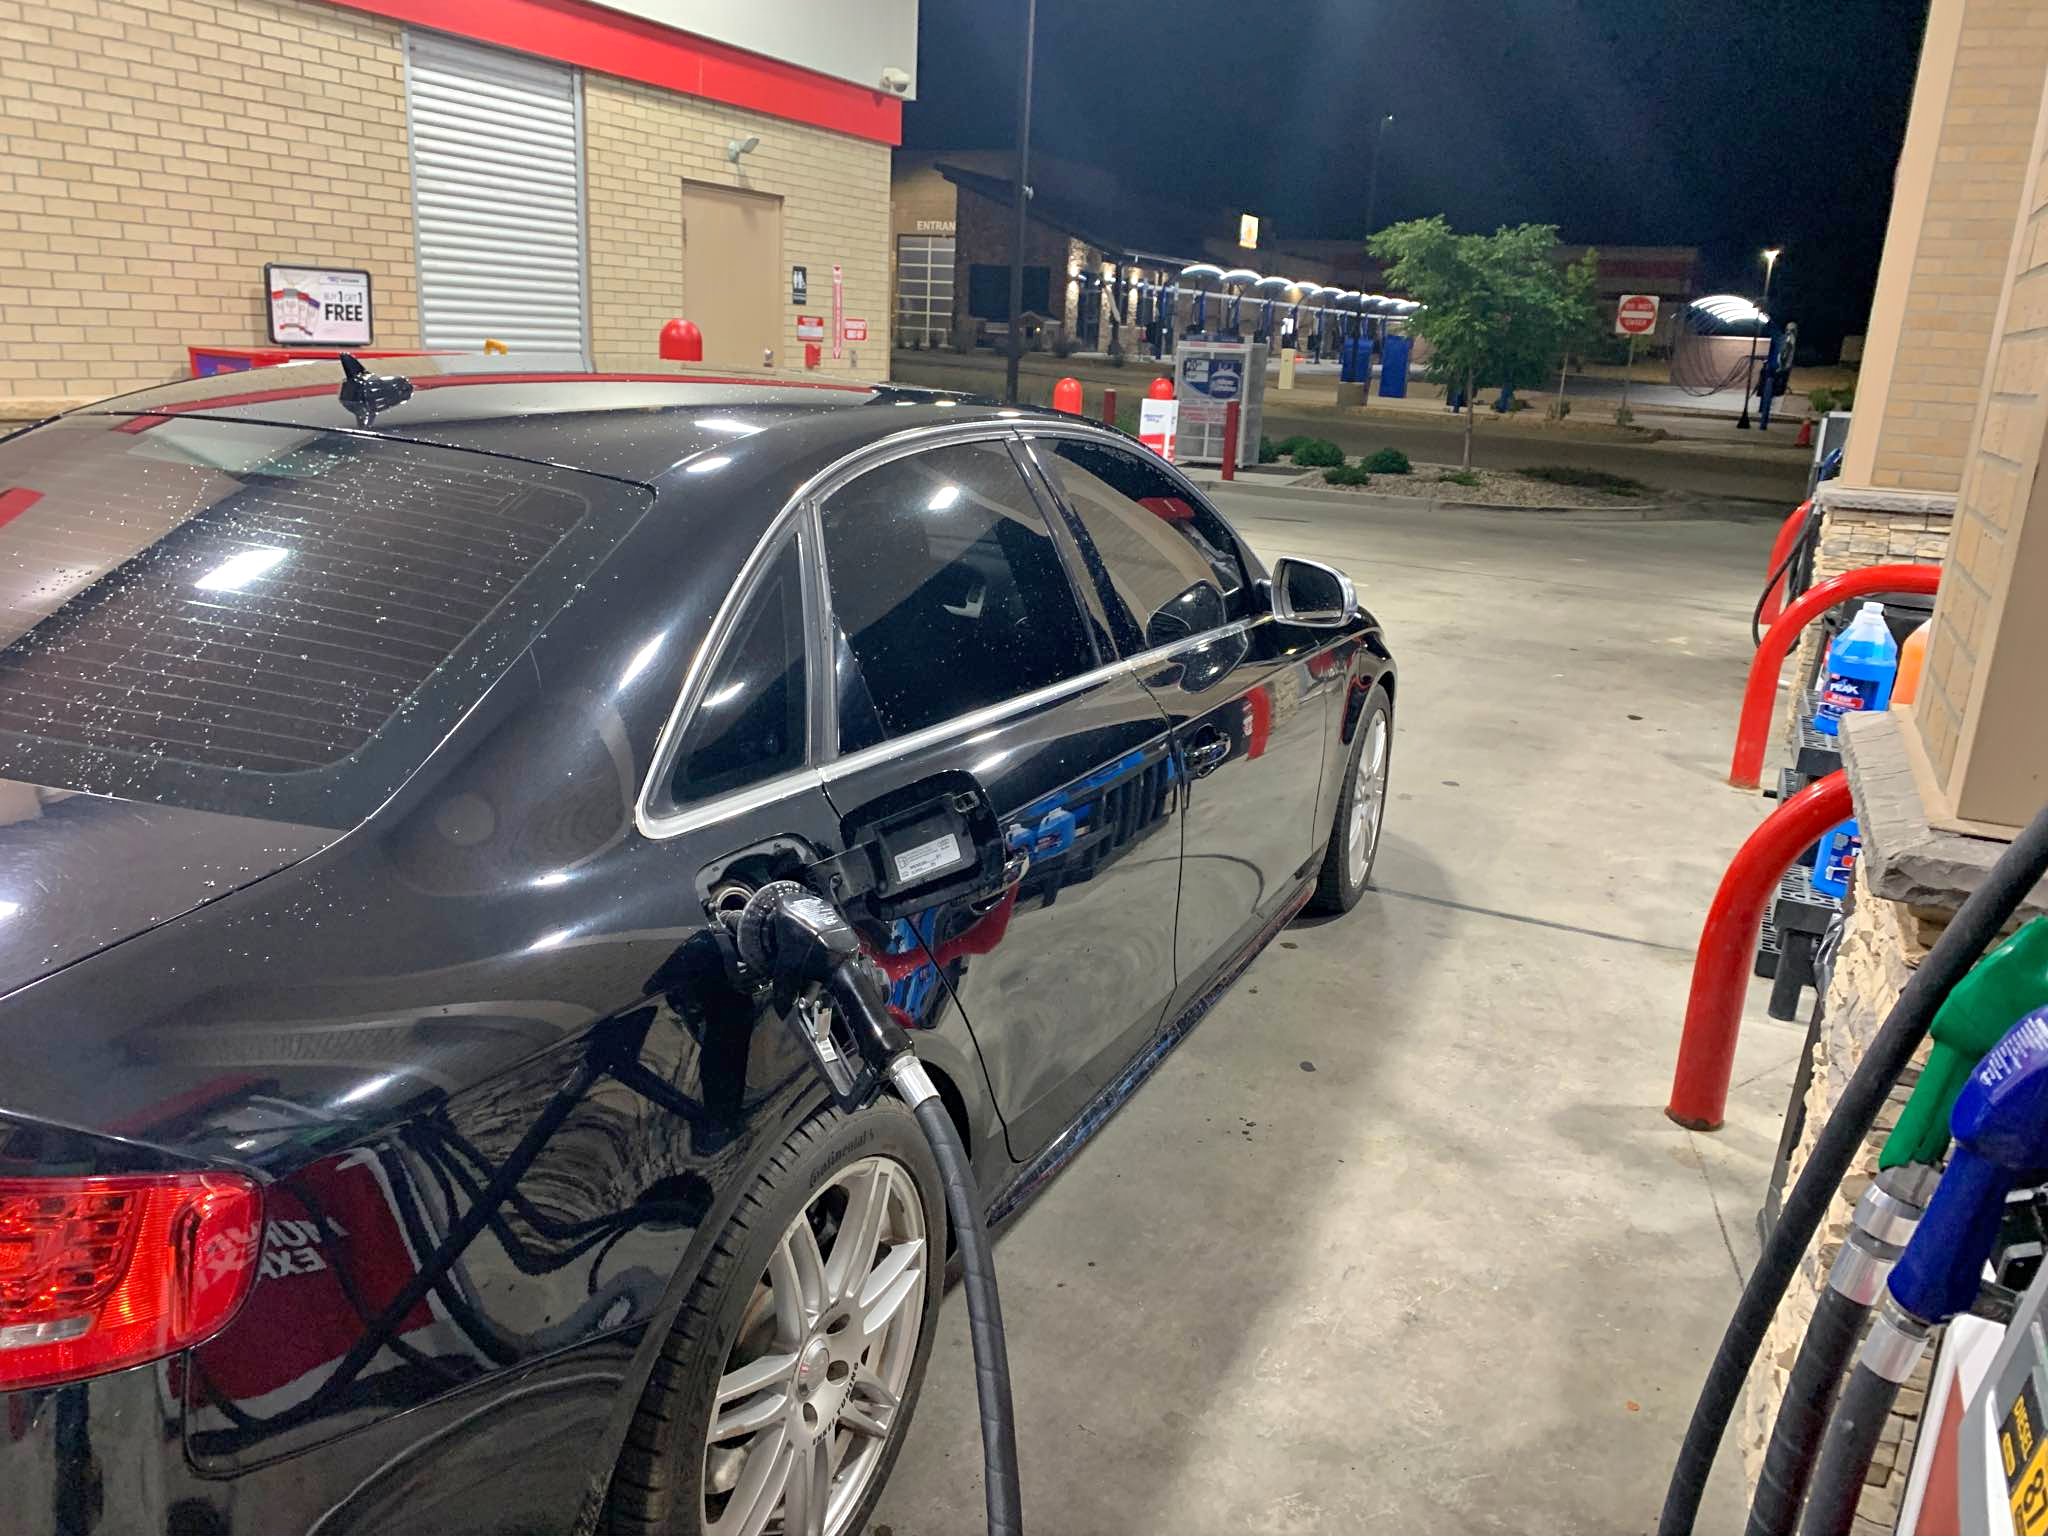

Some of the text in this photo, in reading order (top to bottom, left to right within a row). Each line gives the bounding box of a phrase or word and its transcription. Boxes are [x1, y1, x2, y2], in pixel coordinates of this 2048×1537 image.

[325, 303, 363, 321] FREE
[1830, 682, 1859, 695] PEAK
[837, 1362, 859, 1416] TUNING
[2013, 1394, 2033, 1462] DIESEL
